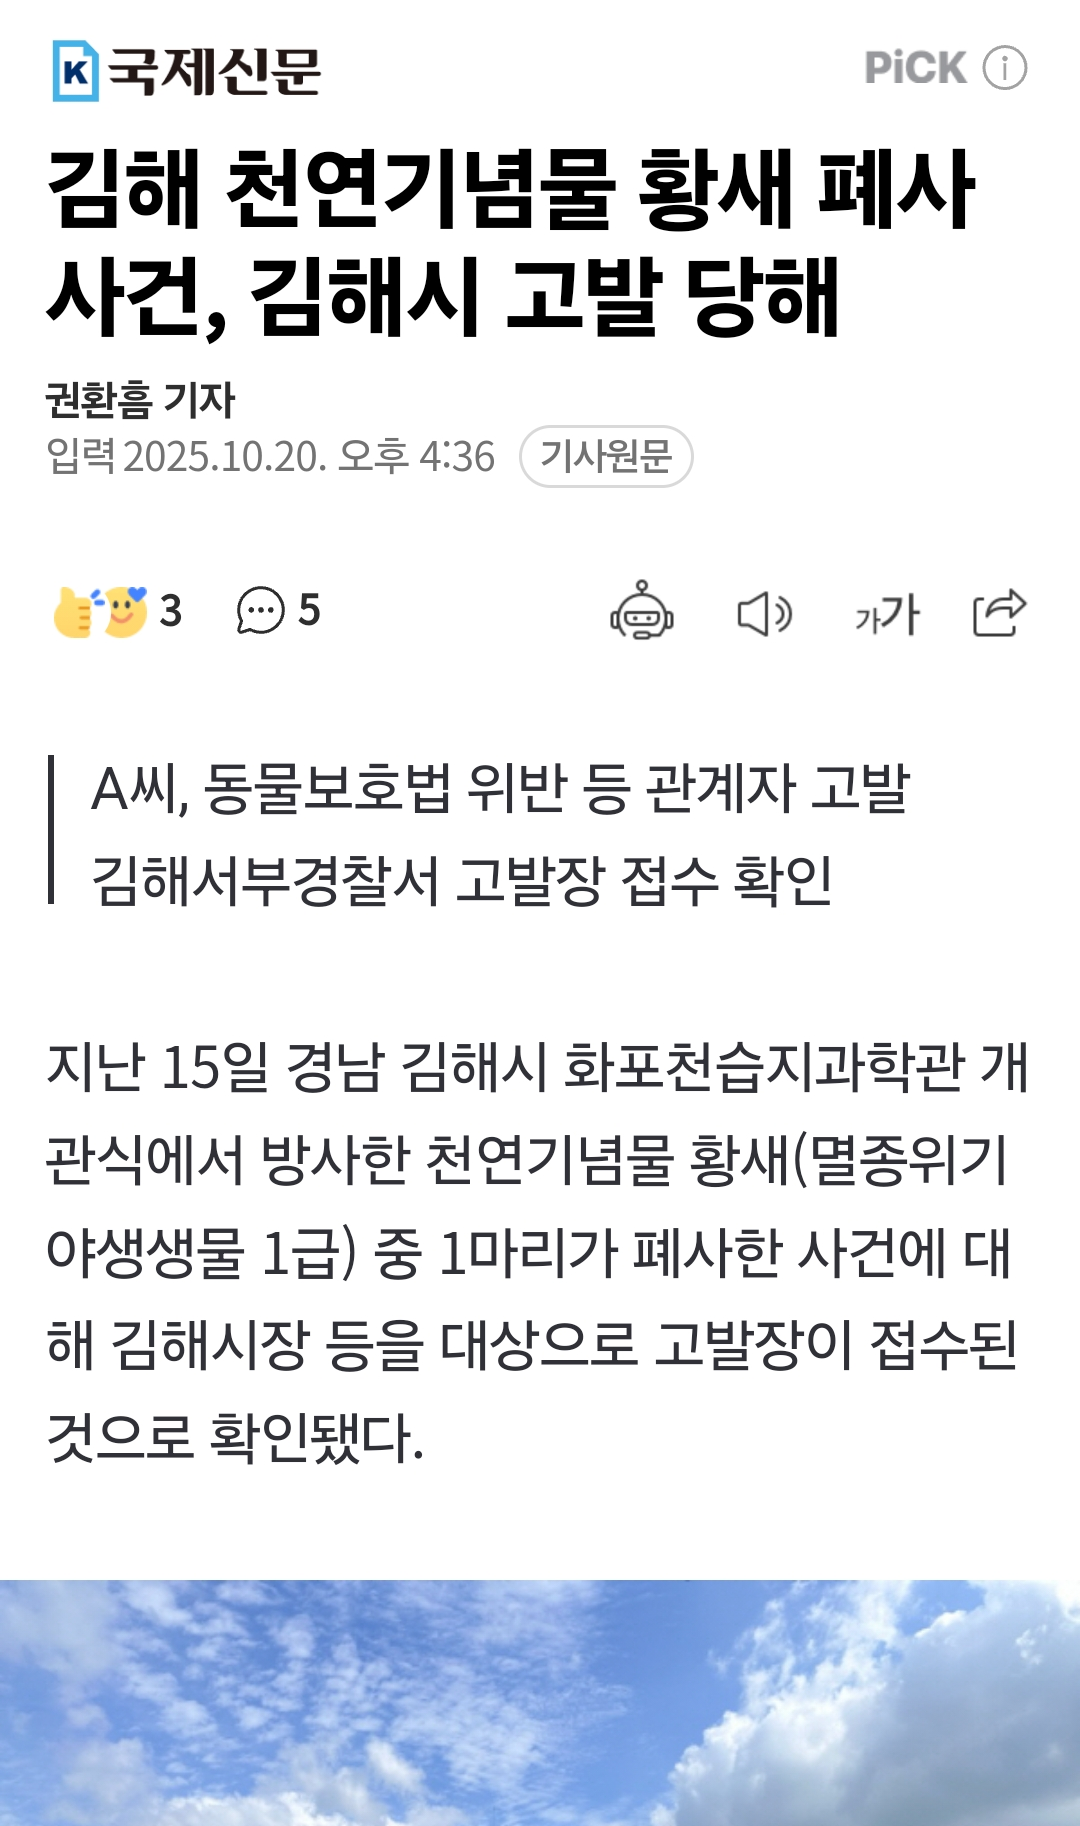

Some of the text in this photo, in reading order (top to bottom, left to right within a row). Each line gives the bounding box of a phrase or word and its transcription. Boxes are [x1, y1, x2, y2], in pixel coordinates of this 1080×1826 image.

[64, 61, 88, 84] K
[108, 48, 321, 96] 국제신문
[867, 49, 967, 83] PiCK
[48, 148, 976, 232] 김해 천연기념물 황새 폐사
[46, 256, 837, 344] 사건, 김해시 고발 당해
[45, 380, 235, 419] 권환흠 기자
[48, 438, 494, 474] 입력 2025.10.20. 오후 4:36
[542, 439, 672, 473] 기사원문
[160, 594, 181, 627] 3
[298, 593, 320, 626] 5
[91, 763, 910, 818] A씨, 동물보호법 위반 등 관계자 고발
[93, 856, 830, 908] 김해서부경찰서 고발장 접수 확인
[47, 1042, 1026, 1093] 지난 15일 경남 김해시 화포천습지과학관 개
[46, 1131, 1004, 1188] 관식에서 방사한 천연기념물 황새(멸종위기
[48, 1224, 1008, 1281] 야생생물 1급) 중 1마리가 폐사한 사건에 대
[47, 1320, 1015, 1372] 해 김해시장 등을 대상으로 고발장이 접수된
[48, 1413, 422, 1465] 것으로 확인됐다.
